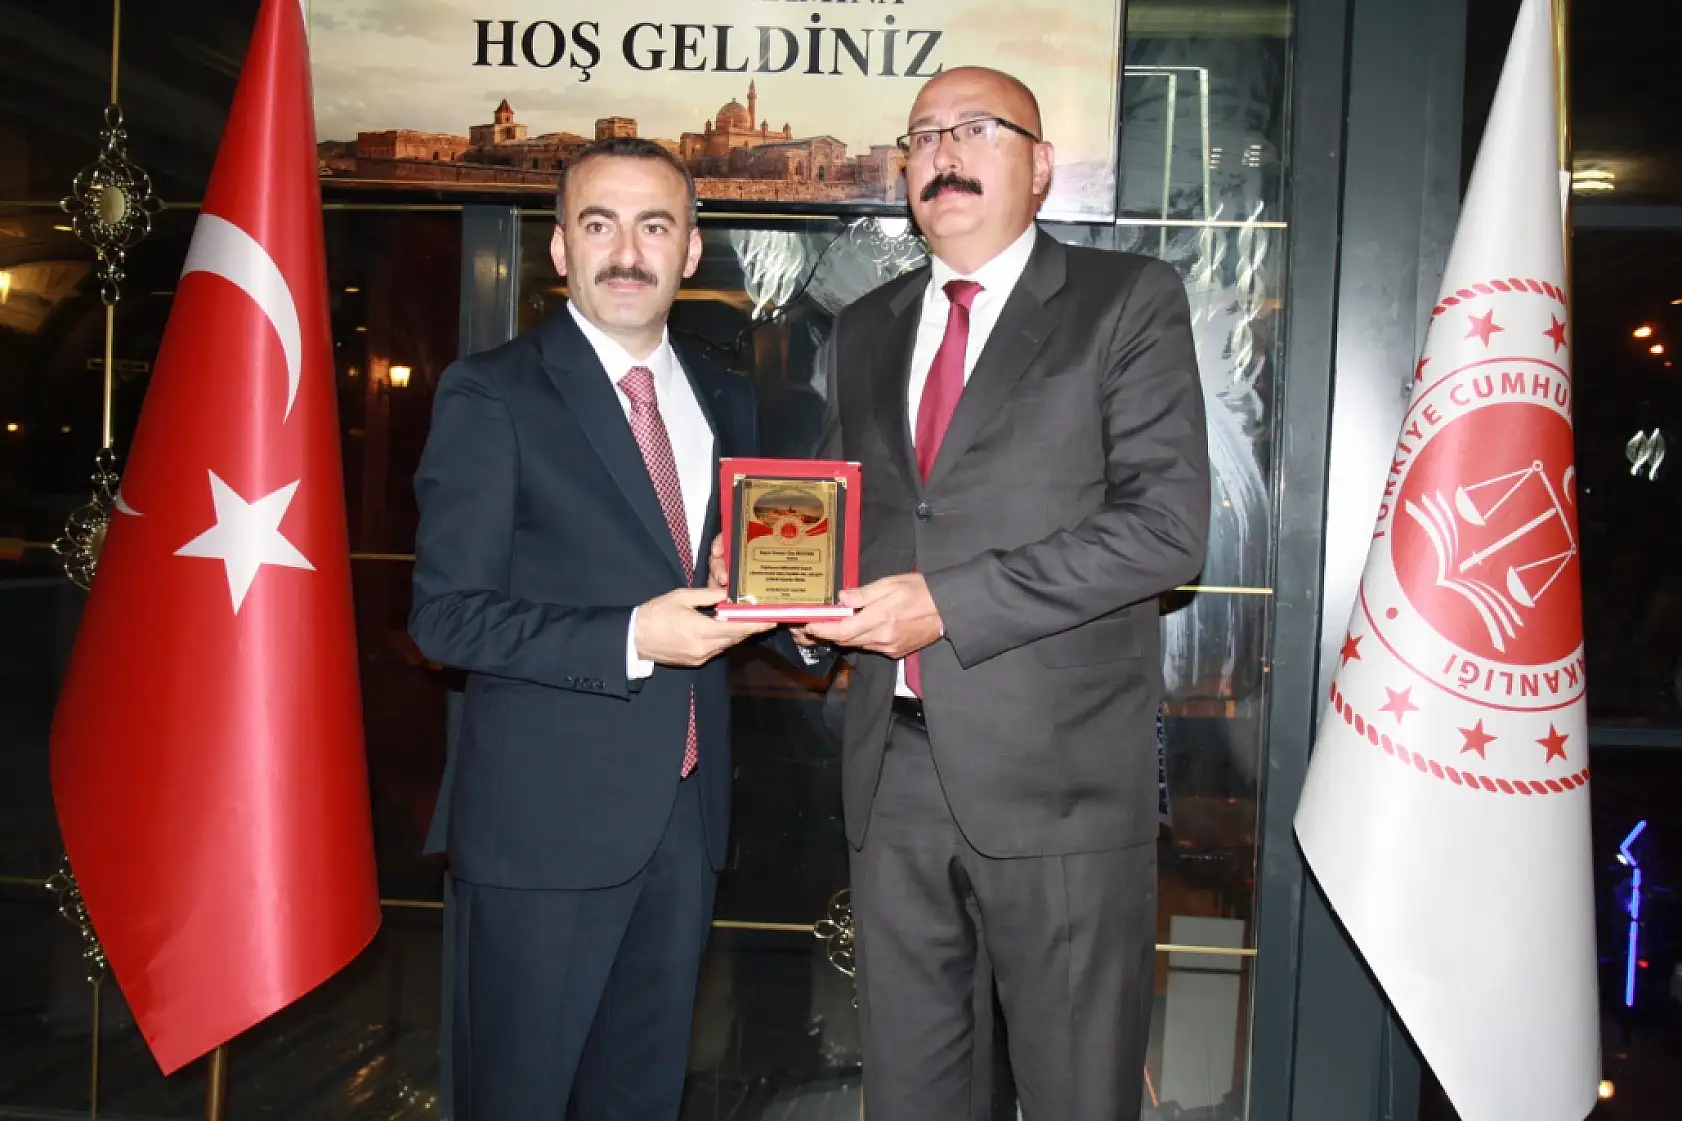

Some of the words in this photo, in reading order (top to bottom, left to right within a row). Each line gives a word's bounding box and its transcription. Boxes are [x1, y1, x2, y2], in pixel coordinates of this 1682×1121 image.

[472, 19, 600, 82] HOŞ
[622, 12, 944, 78] GELDİNİZ
[1450, 371, 1572, 408] CUMHU
